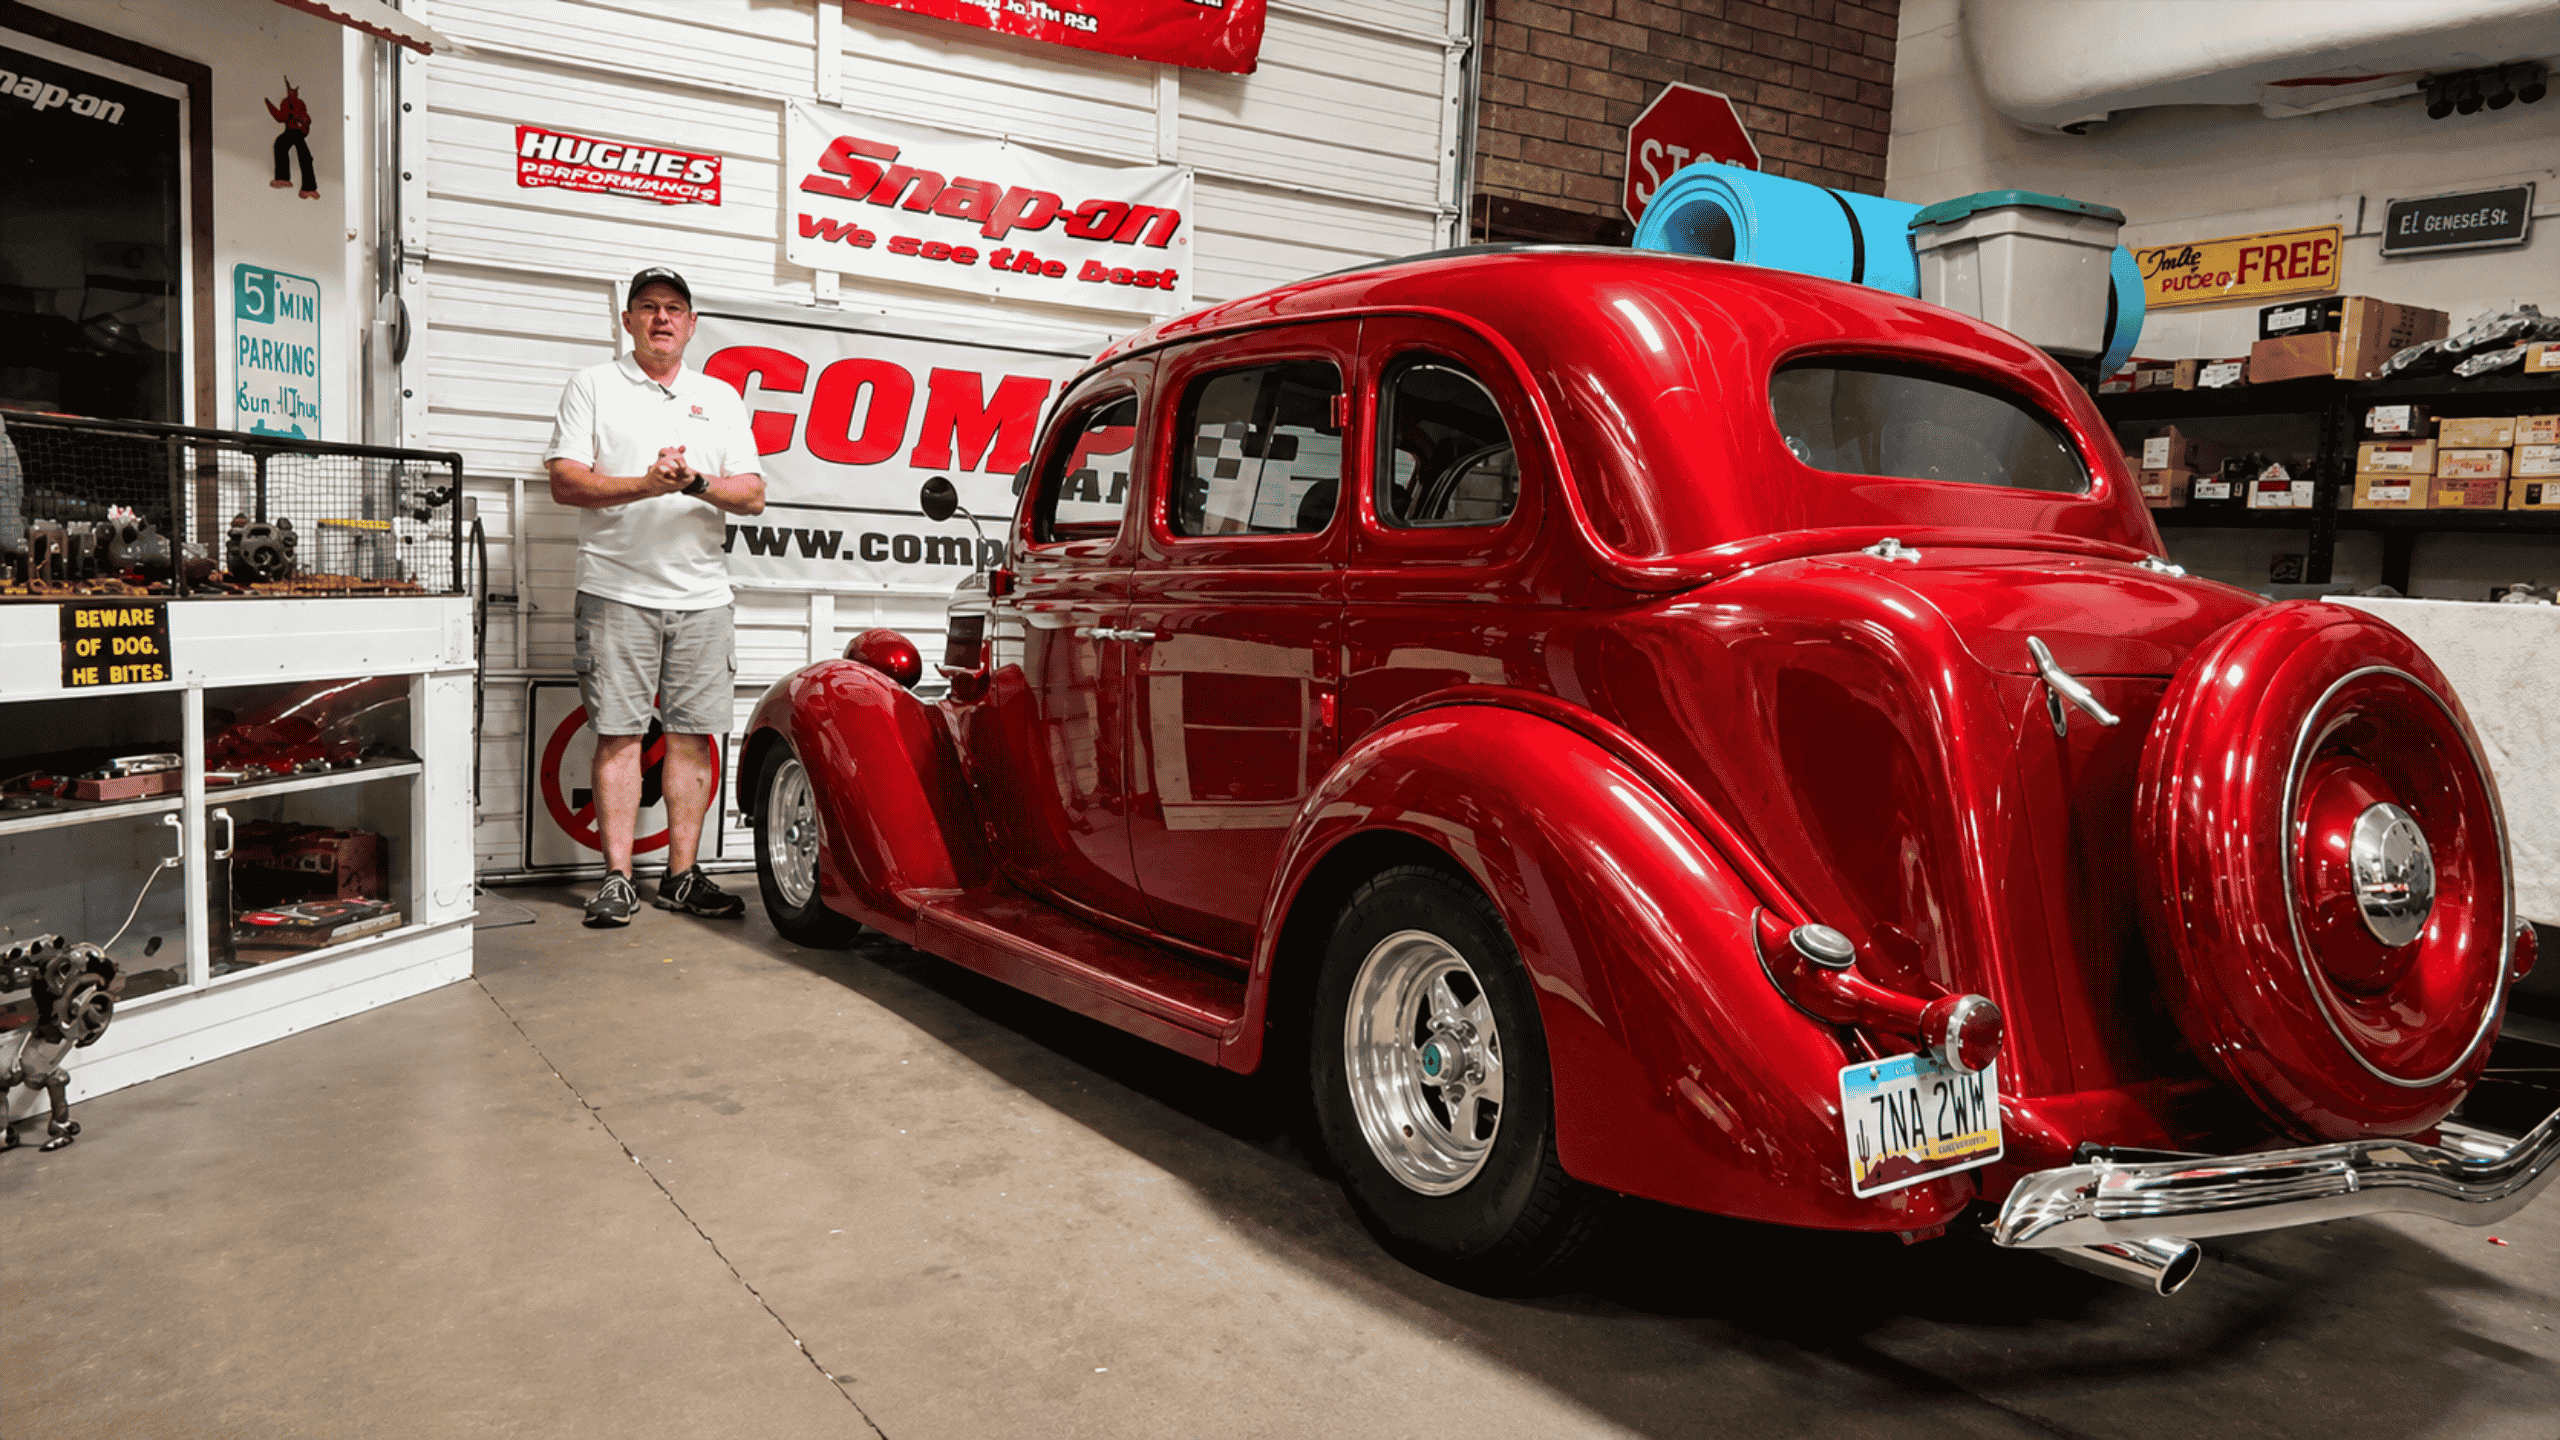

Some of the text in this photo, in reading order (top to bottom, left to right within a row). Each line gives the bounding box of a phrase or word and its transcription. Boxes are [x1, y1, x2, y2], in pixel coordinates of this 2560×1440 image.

[520, 131, 718, 184] HUGHES
[1635, 137, 1746, 205] ST
[798, 134, 1182, 248] Snap-on
[798, 212, 1180, 291] We see the best
[2236, 238, 2333, 285] FREE
[244, 271, 314, 323] 5 MIN
[239, 333, 316, 378] PARKING
[75, 608, 155, 628] BEWARE
[75, 636, 159, 657] OF DOG.
[72, 666, 99, 685] HE
